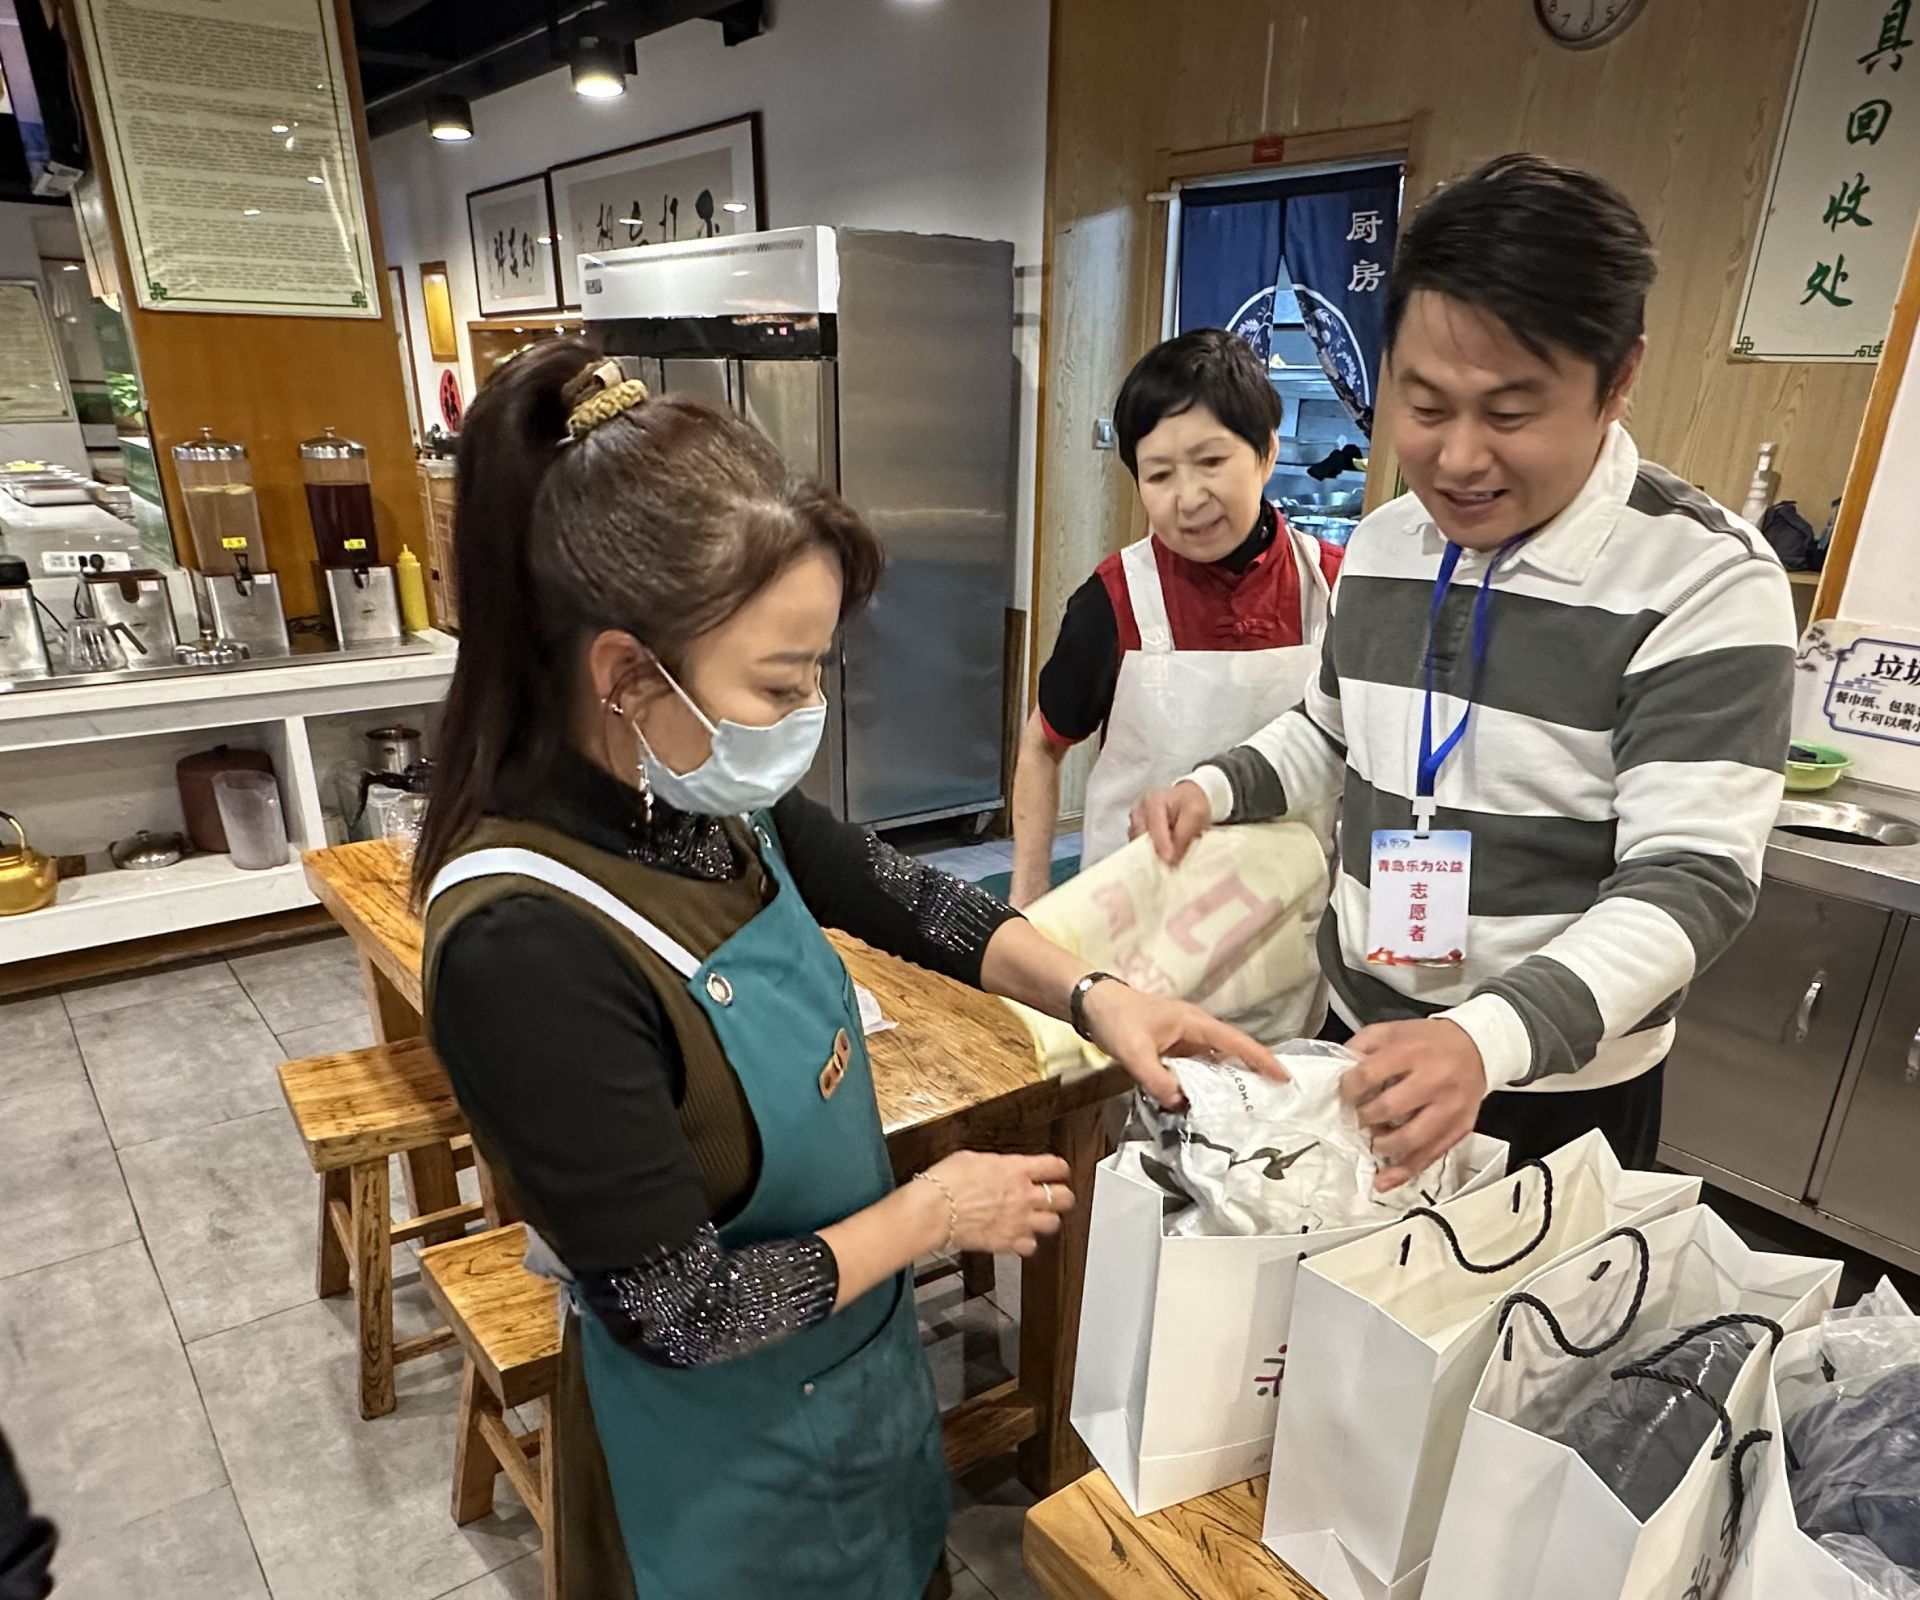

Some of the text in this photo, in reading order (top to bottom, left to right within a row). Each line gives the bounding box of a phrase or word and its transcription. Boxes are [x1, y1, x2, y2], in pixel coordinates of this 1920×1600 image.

[1561, 13, 1571, 30] 7
[1605, 5, 1617, 23] 5
[1581, 17, 1594, 33] 6
[1800, 0, 1914, 307] 具回收处
[1346, 210, 1386, 293] 厨房
[1378, 859, 1464, 873] 青岛乐为公益
[1408, 882, 1428, 942] 志愿者
